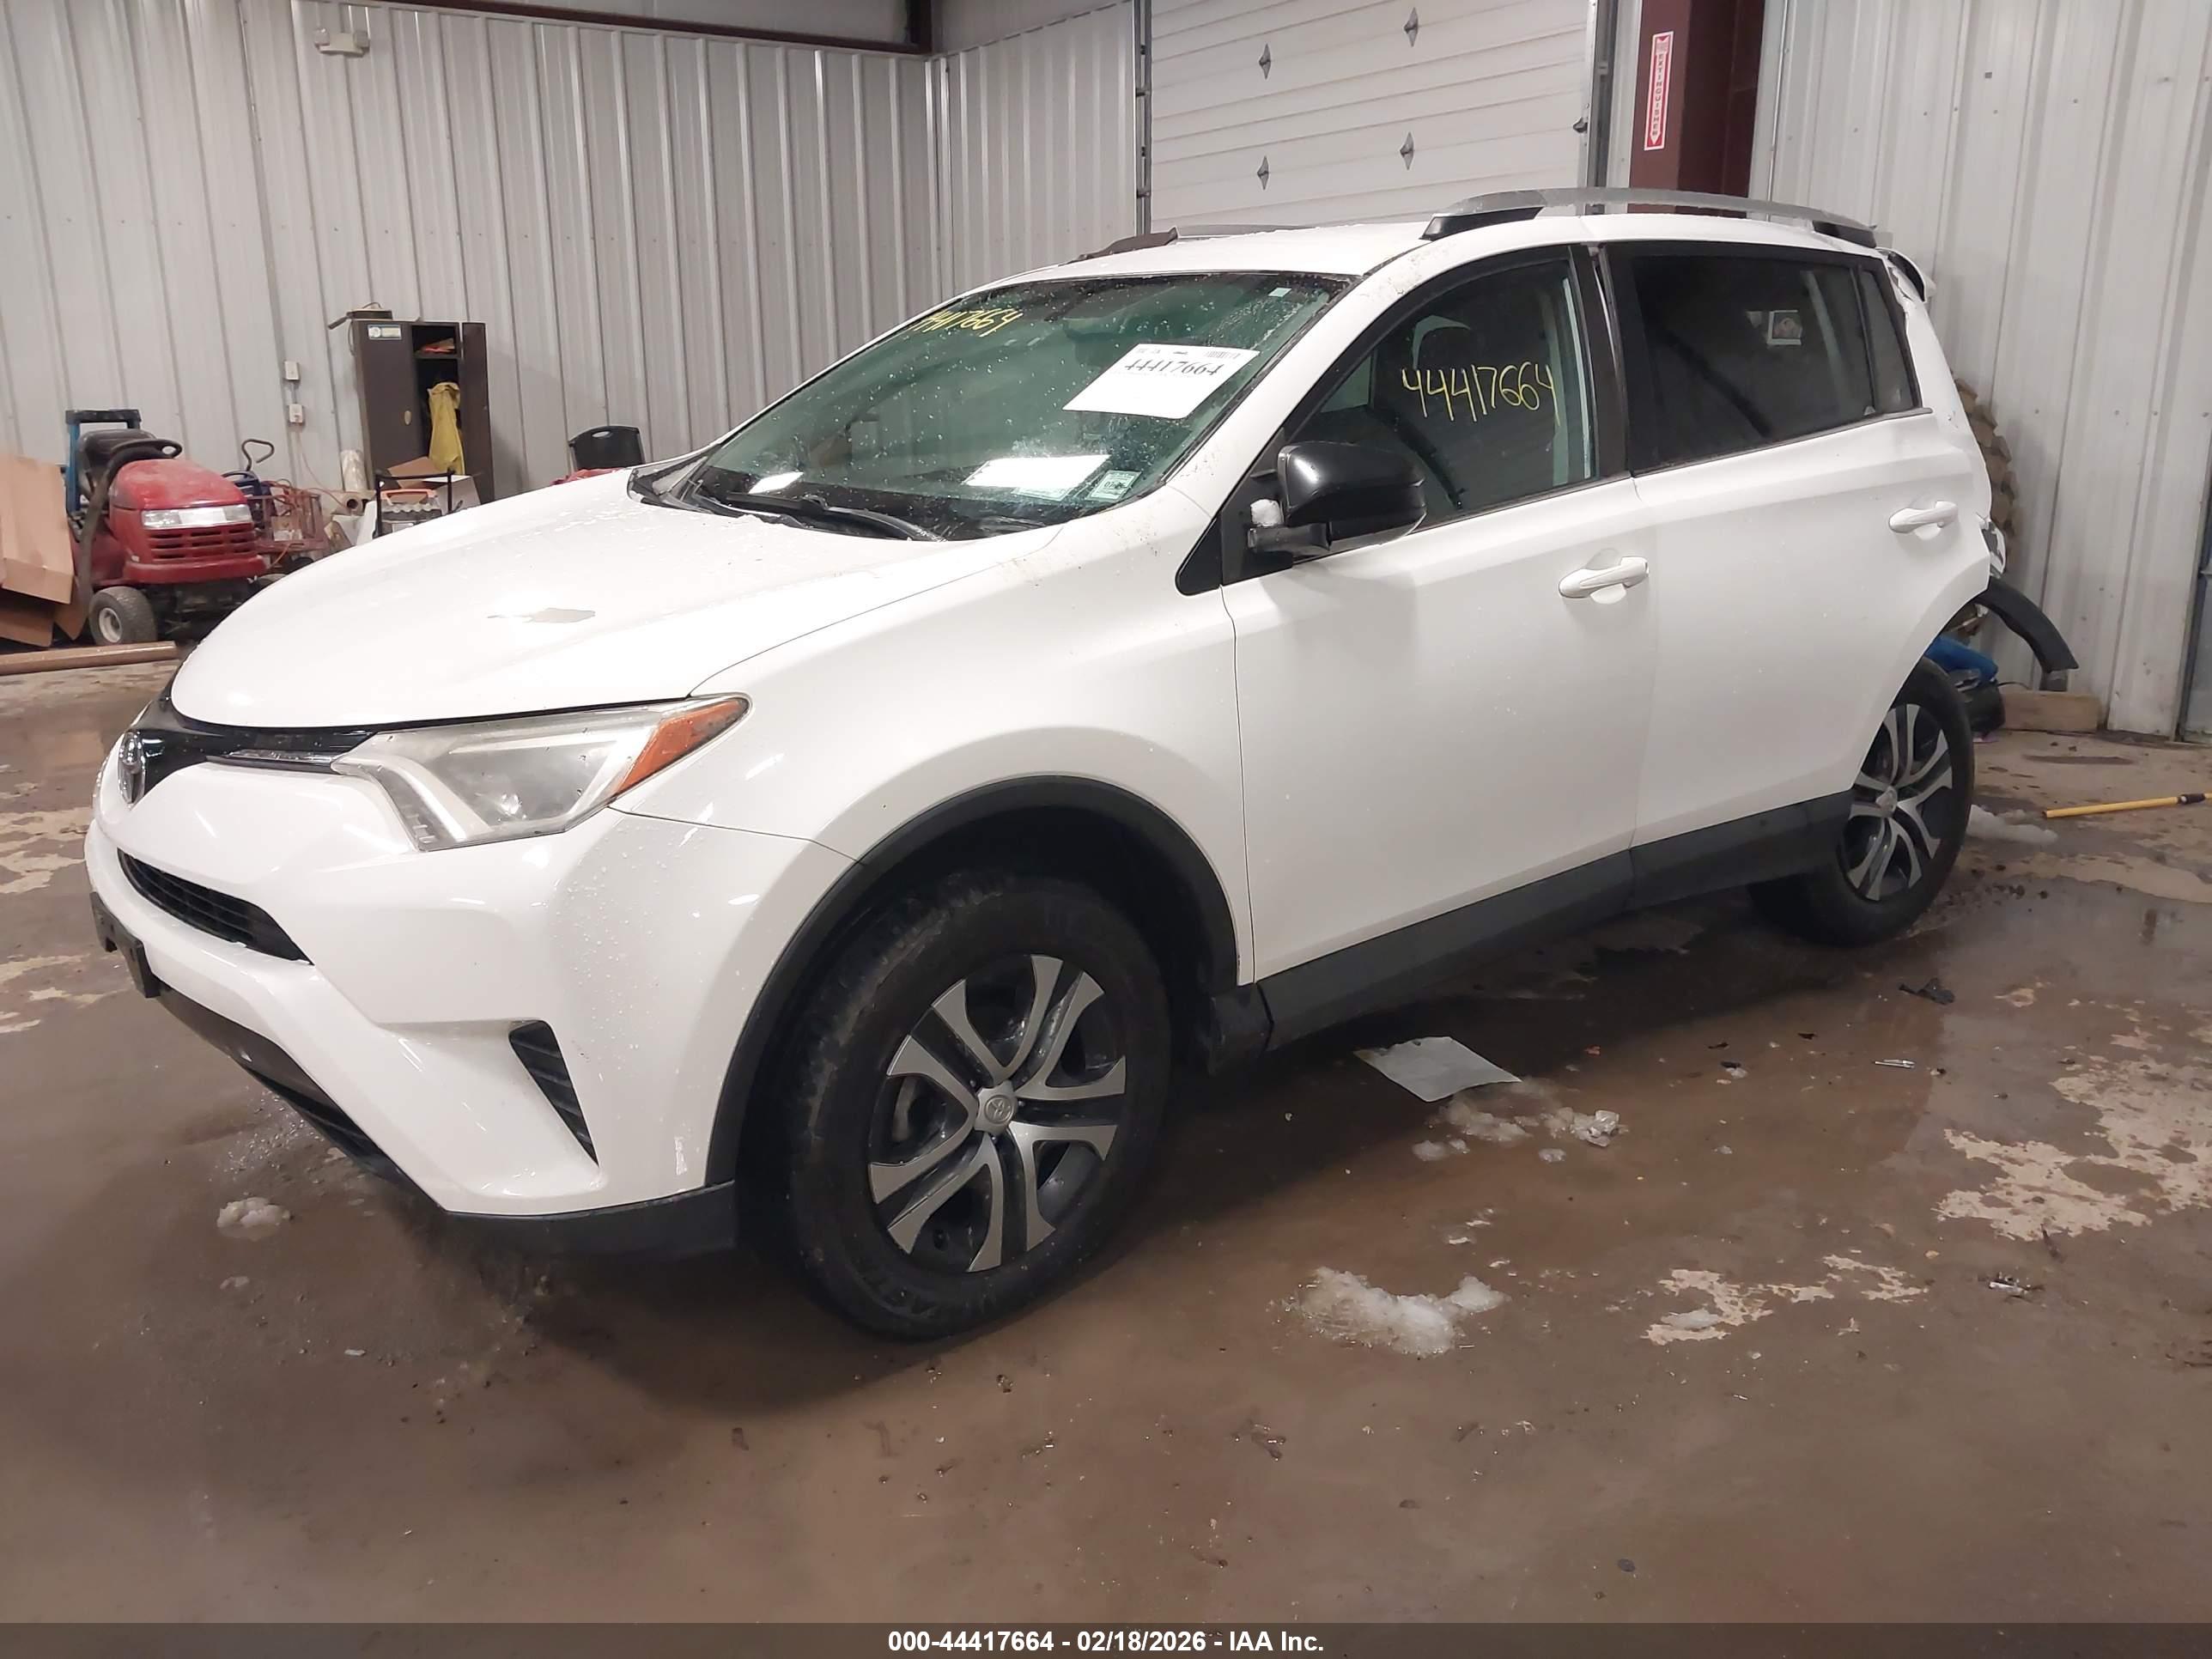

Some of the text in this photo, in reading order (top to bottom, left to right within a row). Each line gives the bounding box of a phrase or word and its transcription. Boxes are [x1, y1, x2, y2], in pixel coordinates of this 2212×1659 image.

[1652, 53, 1664, 136] EXTINGUISHER
[1125, 358, 1224, 376] 44417664
[1401, 361, 1561, 427] 44417664
